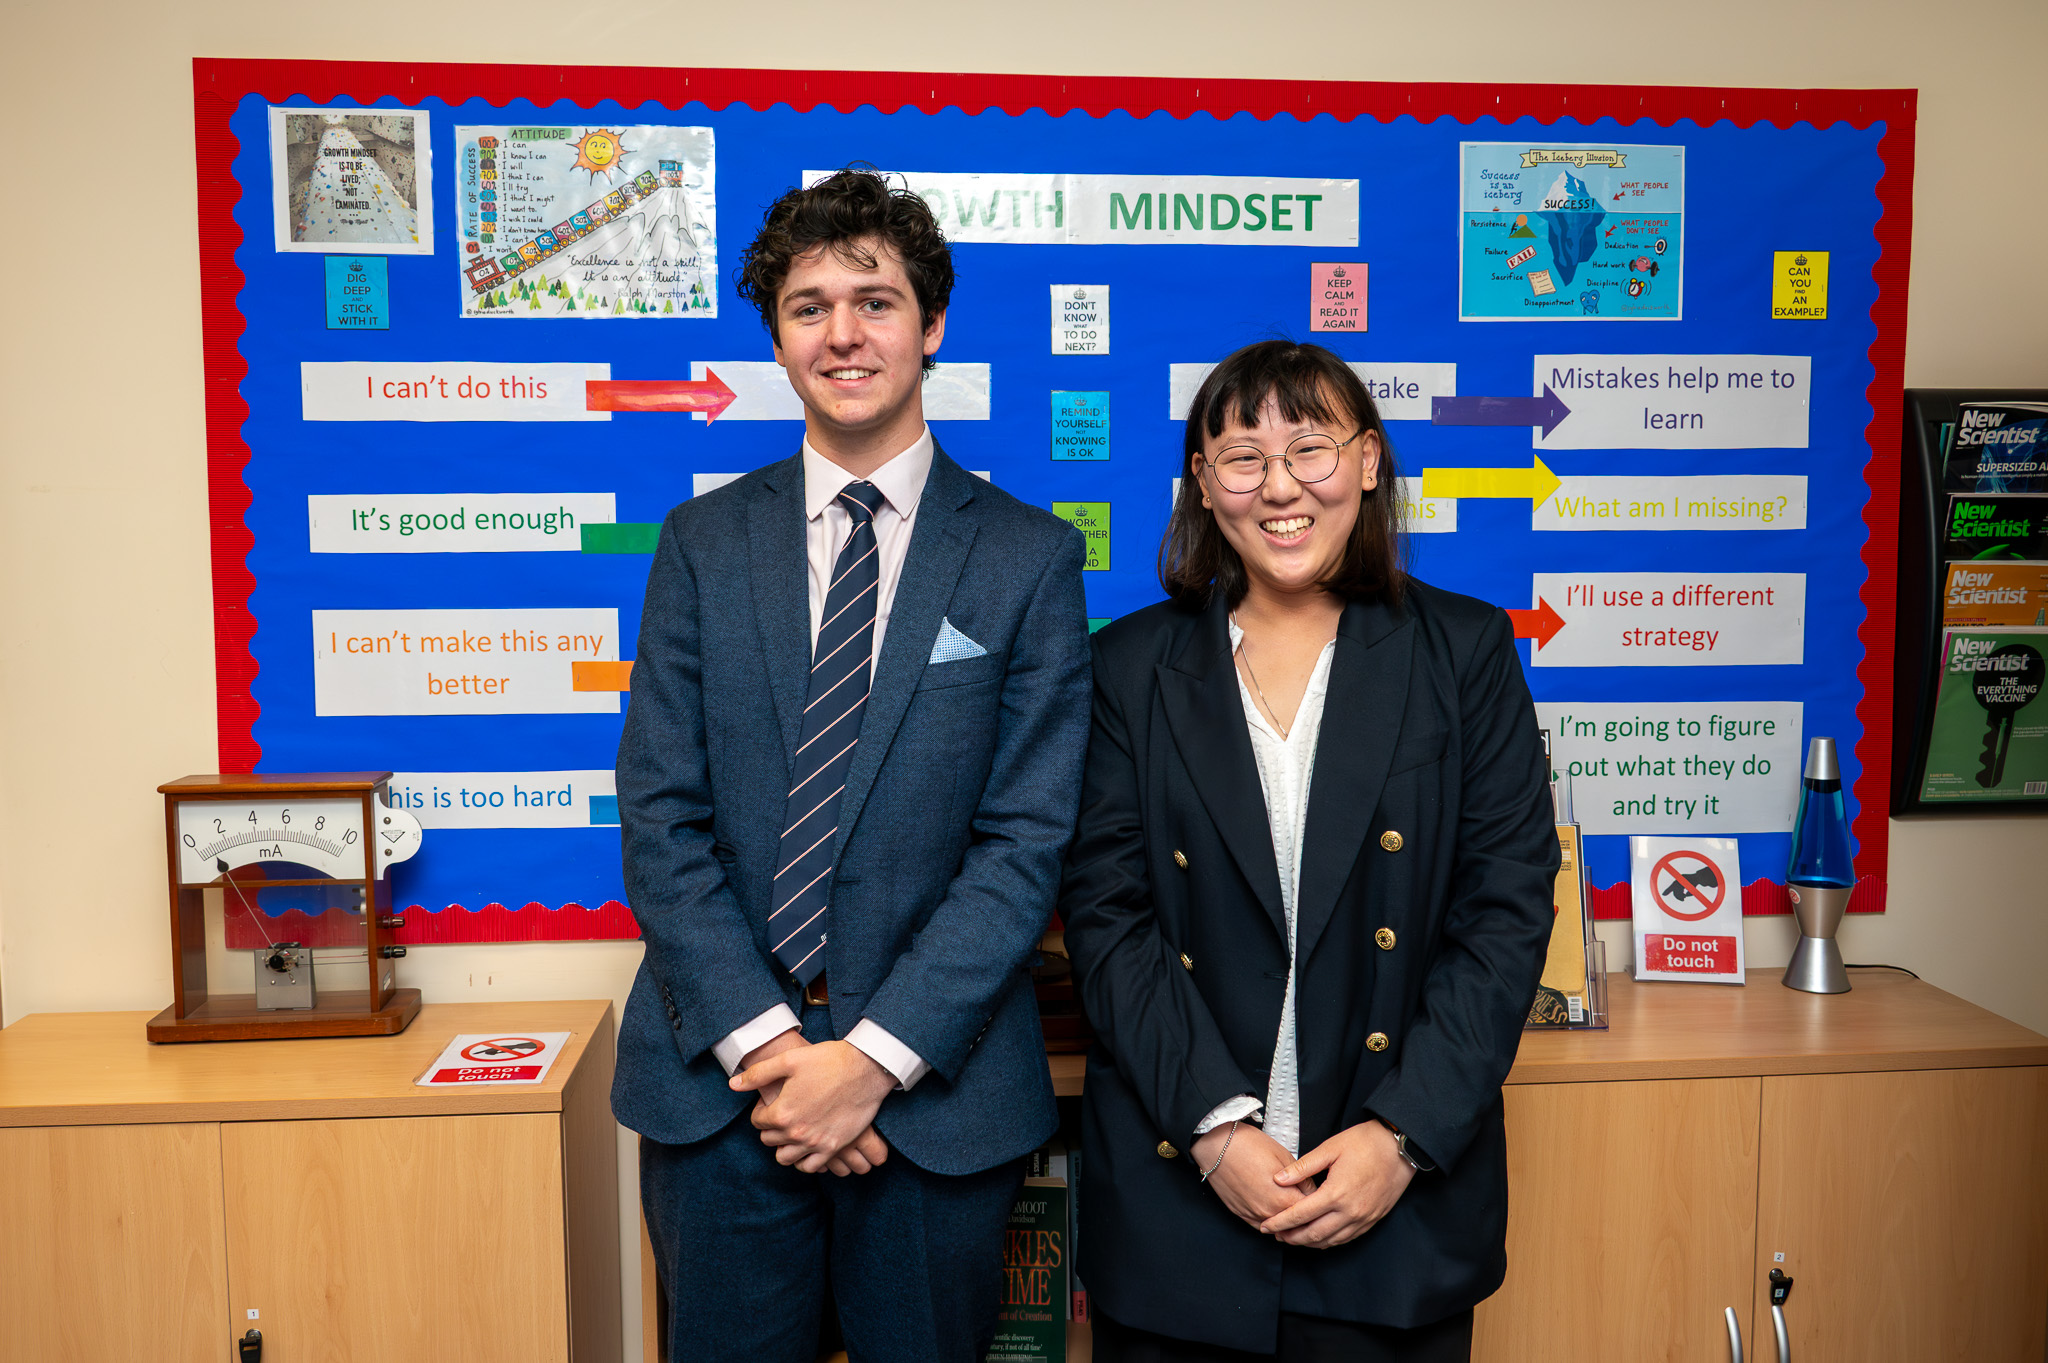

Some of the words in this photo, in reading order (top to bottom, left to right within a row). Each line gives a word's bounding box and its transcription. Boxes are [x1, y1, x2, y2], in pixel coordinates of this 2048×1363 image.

[511, 129, 565, 139] ATTITUDE
[324, 148, 349, 157] GROWTH
[351, 148, 376, 157] MINDSET
[1533, 152, 1549, 161] The
[1552, 152, 1583, 165] Iceberg
[1586, 153, 1614, 162] Illusion
[339, 162, 344, 170] IS
[346, 162, 354, 170] TO
[356, 162, 363, 170] BE
[467, 148, 476, 186] SUCCESS
[1480, 169, 1520, 180] Success
[346, 188, 357, 196] NOT
[1490, 181, 1500, 189] is
[468, 192, 477, 203] OF
[1484, 189, 1523, 205] iceberg
[336, 201, 371, 209] LAMINATED.
[918, 188, 1063, 228] OWTH
[1110, 192, 1322, 231] MINDSET
[1544, 199, 1595, 210] SUCCESS!
[468, 212, 478, 237] RATE
[1471, 220, 1507, 228] Persistence
[1605, 242, 1639, 250] Dedication
[626, 258, 634, 266] is
[1508, 247, 1536, 268] FAIL
[347, 274, 366, 282] DIG
[1491, 273, 1524, 281] Sacrifice
[1586, 279, 1619, 288] Discipline
[343, 286, 370, 295] DEEP
[1325, 291, 1354, 299] CALM
[342, 304, 373, 313] STICK
[1064, 302, 1096, 310] DON'T
[1524, 299, 1574, 309] Disappointment
[338, 317, 366, 325] WITH
[369, 317, 378, 325] IT
[1064, 314, 1096, 322] KNOW
[1323, 320, 1355, 328] AGAIN
[1064, 331, 1078, 339] TO
[1081, 331, 1097, 339] DO
[368, 377, 372, 398] I
[383, 375, 448, 398] can't
[458, 375, 490, 398] do
[499, 376, 547, 398] this
[1552, 367, 1660, 390] Mistakes
[1669, 366, 1718, 393] help
[1728, 373, 1763, 388] me
[1771, 369, 1794, 388] to
[1368, 377, 1419, 398] take
[1062, 408, 1100, 416] REMIND
[1645, 408, 1703, 429] learn
[1961, 410, 2007, 428] New
[1957, 427, 2040, 445] Scientist
[1976, 462, 2037, 472] SUPERSIZED
[1555, 496, 1620, 517] What
[1629, 502, 1664, 517] am
[1675, 497, 1678, 517] I
[1689, 496, 1787, 522] missing?
[1954, 502, 1997, 520] New
[353, 508, 390, 530] It's
[400, 507, 464, 536] good
[476, 506, 573, 534] enough
[1951, 518, 2031, 537] Scientist
[1951, 570, 1994, 587] New
[1568, 585, 1593, 606] I'll
[1604, 591, 1643, 606] use
[1652, 591, 1663, 606] a
[1673, 584, 1774, 606] different
[1948, 586, 2028, 604] Scientist
[332, 632, 336, 653] I
[347, 630, 411, 653] can't
[421, 630, 491, 652] make
[500, 629, 548, 652] this
[558, 635, 603, 656] any
[1622, 628, 1718, 651] strategy
[1954, 638, 1996, 655] New
[1950, 654, 2030, 672] Scientist
[428, 673, 510, 695] better
[2000, 677, 2019, 685] THE
[1977, 685, 2037, 695] EVERYTHING
[1986, 694, 2026, 703] VACCINE
[1561, 715, 1595, 736] I'm
[1605, 716, 1669, 742] going
[1677, 718, 1700, 736] to
[1708, 715, 1775, 741] figure
[1569, 759, 1608, 776] out
[1617, 755, 1675, 776] what
[1683, 755, 1735, 780] they
[1743, 754, 1771, 775] do
[389, 785, 424, 808] his
[434, 787, 451, 808] is
[460, 789, 504, 807] too
[514, 784, 571, 807] hard
[1613, 794, 1655, 815] and
[1664, 797, 1696, 820] try
[1705, 795, 1719, 814] it
[183, 834, 196, 848] 0
[213, 818, 226, 834] 2
[248, 810, 257, 824] 4
[282, 809, 290, 824] 6
[314, 815, 325, 831] 8
[342, 828, 357, 845] 10
[259, 844, 282, 858] mA
[1664, 938, 1686, 951] Do
[1691, 939, 1718, 952] not
[1667, 954, 1714, 968] touch
[1000, 1268, 1051, 1305] TIME
[1020, 1310, 1052, 1321] Creation
